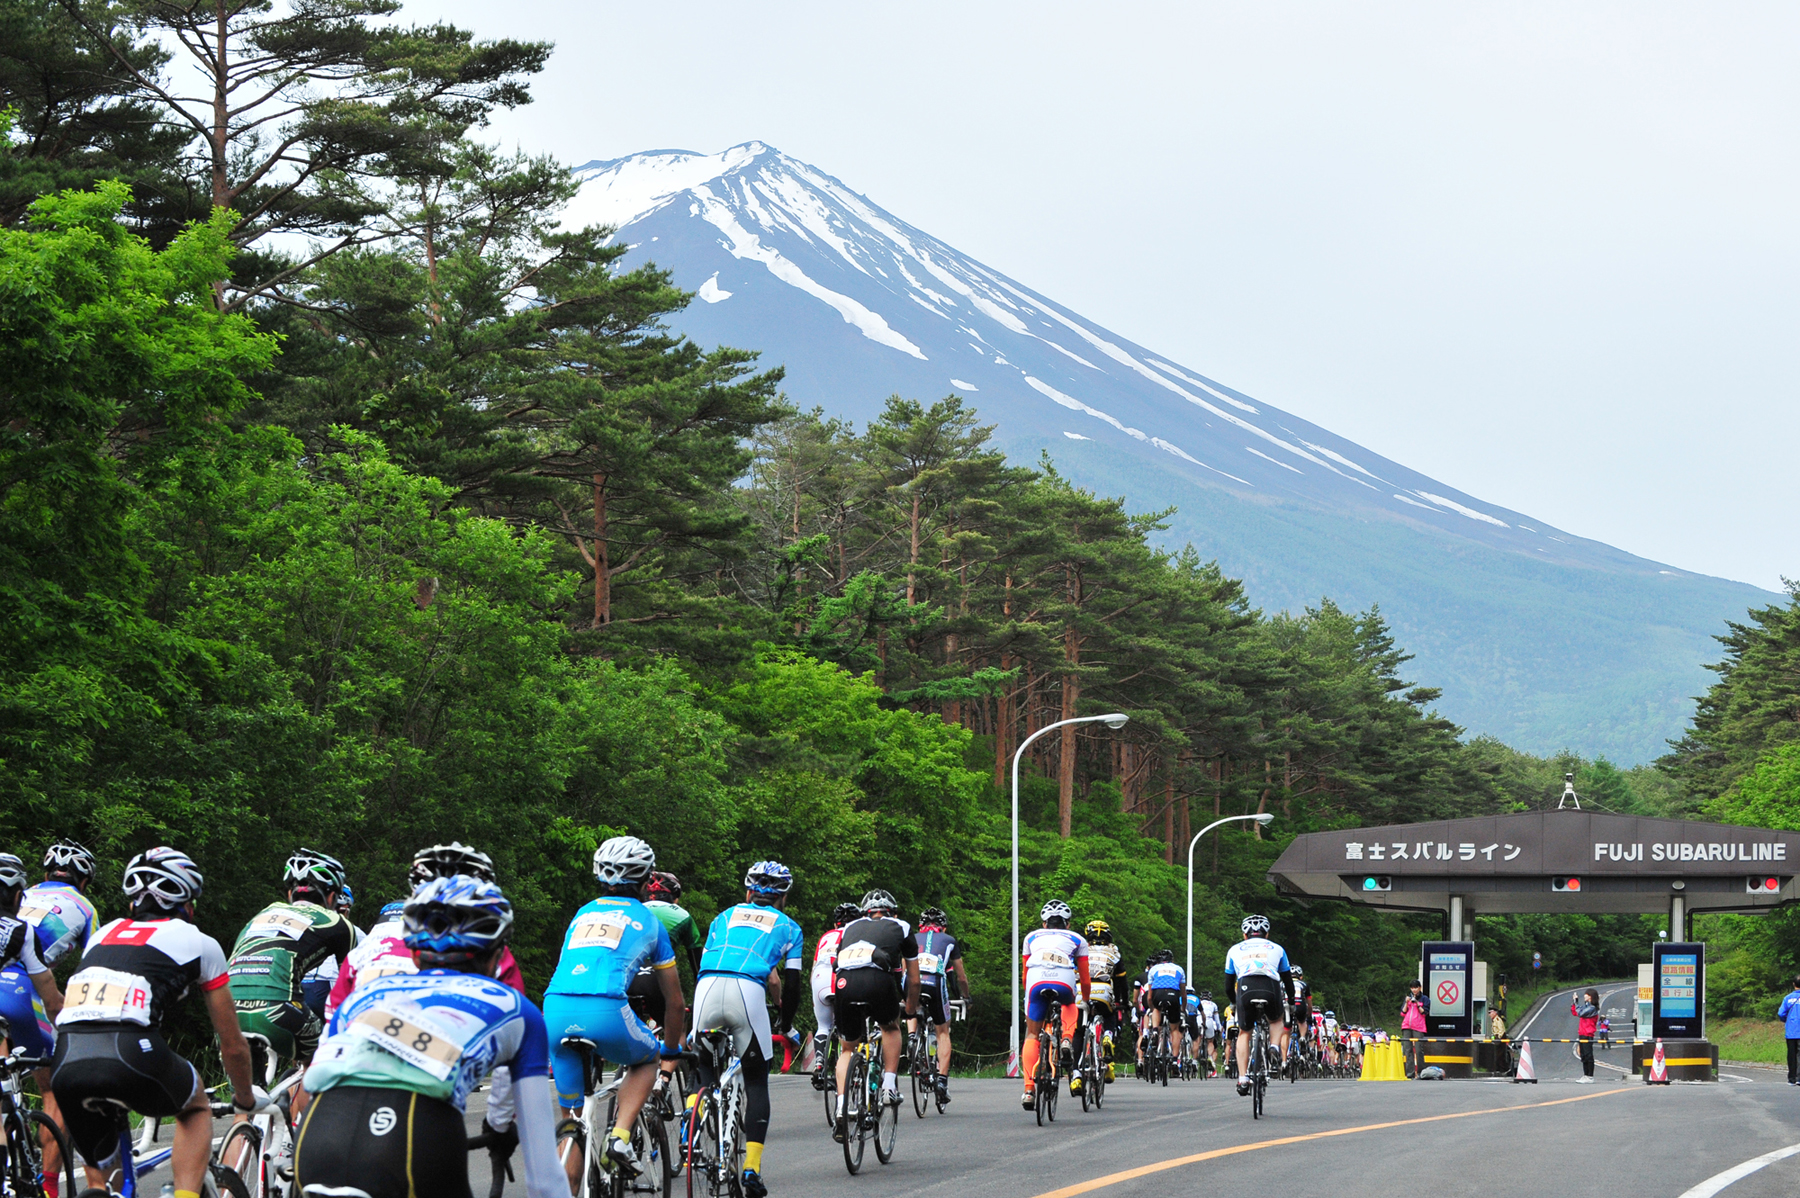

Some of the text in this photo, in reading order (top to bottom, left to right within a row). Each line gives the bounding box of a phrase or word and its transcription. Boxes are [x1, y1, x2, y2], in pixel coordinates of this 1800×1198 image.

[1345, 842, 1522, 862] 富士スバルライン
[1594, 843, 1787, 861] FUJI SUBARU LINE
[268, 915, 294, 926] 86
[742, 914, 764, 923] 90
[585, 923, 610, 938] 75
[848, 948, 864, 959] 72
[1049, 953, 1064, 963] 48
[1662, 966, 1693, 974] 道路情報
[78, 982, 108, 1006] 94
[384, 1018, 432, 1052] 88
